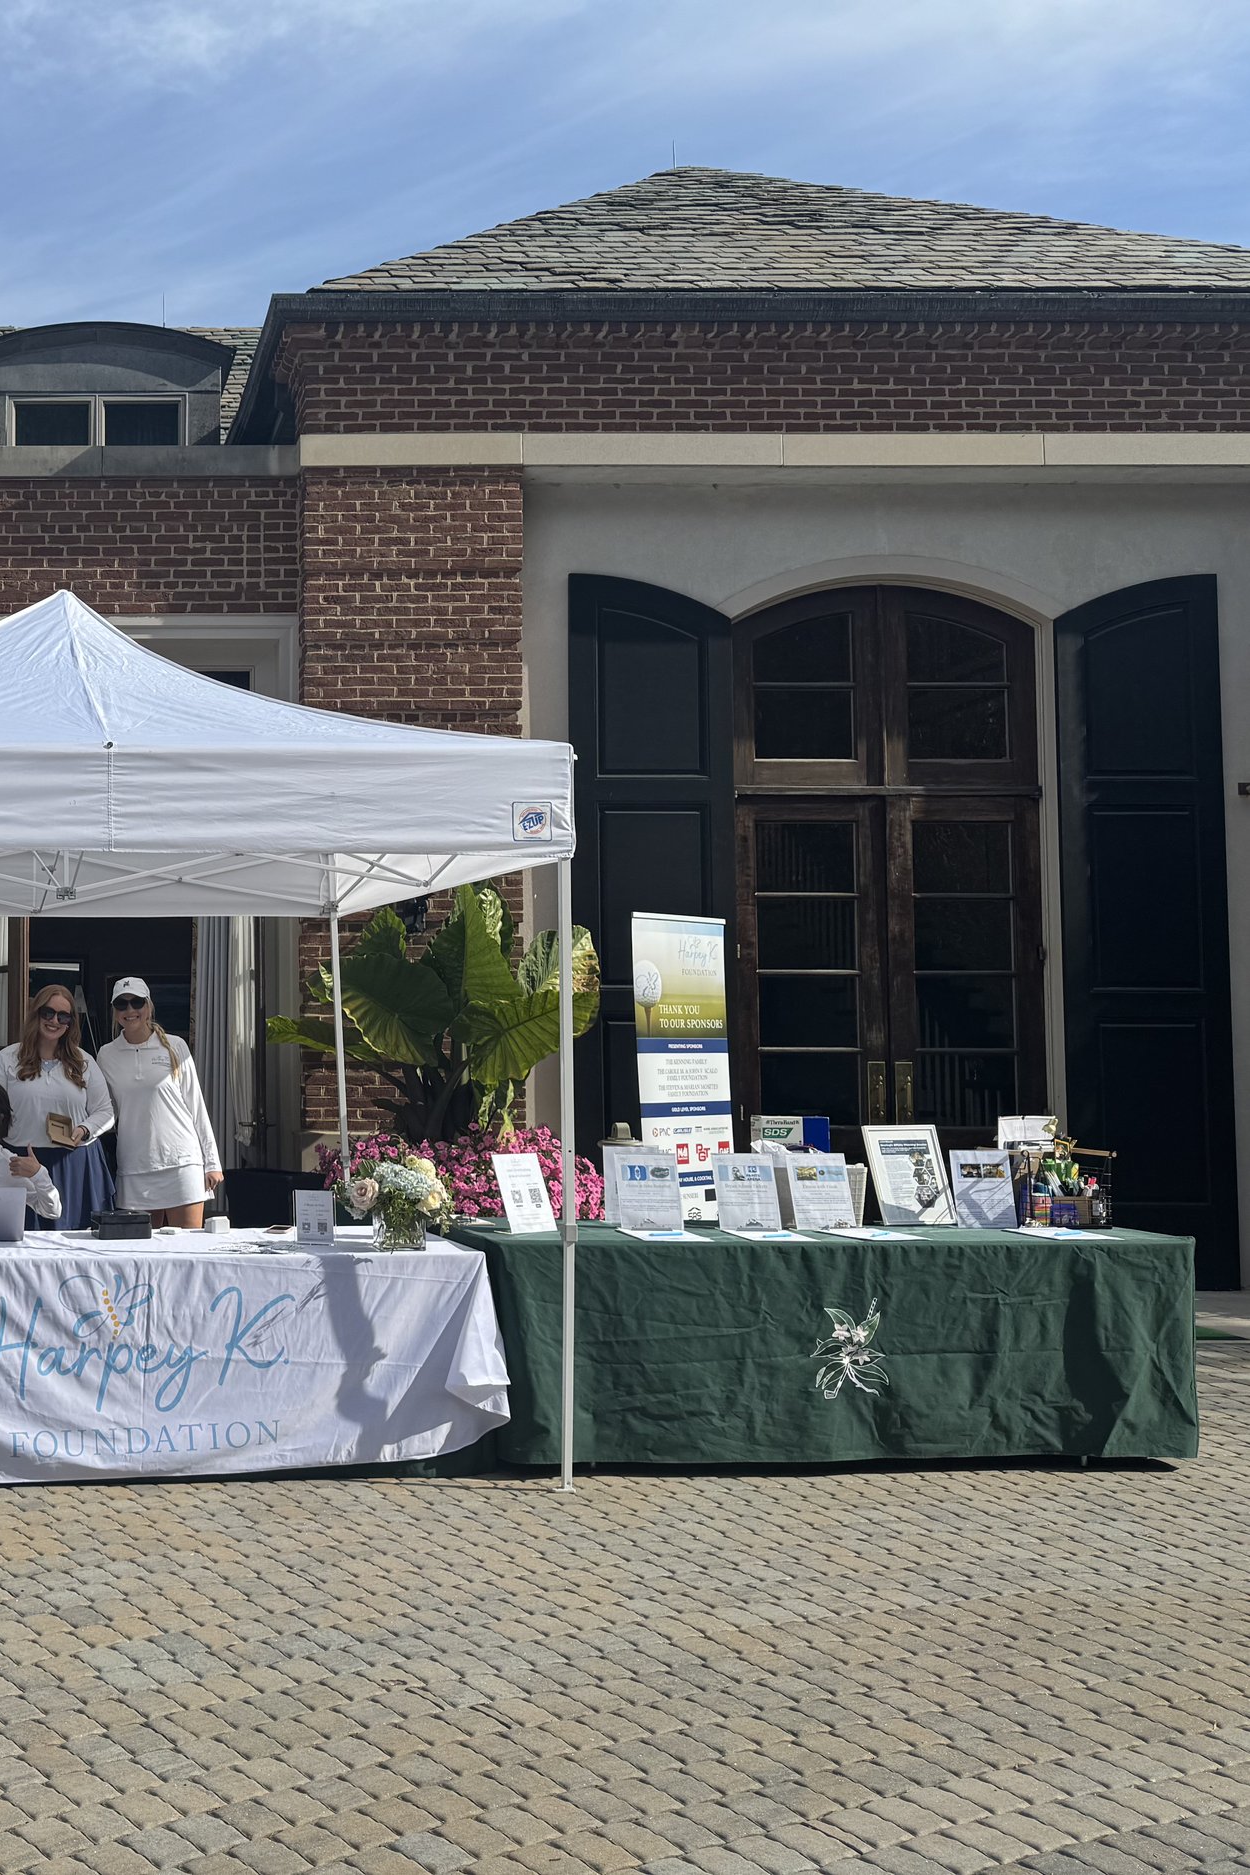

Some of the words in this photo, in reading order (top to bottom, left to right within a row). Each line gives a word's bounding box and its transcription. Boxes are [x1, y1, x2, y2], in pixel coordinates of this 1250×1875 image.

[658, 1004, 683, 1014] THANK
[684, 1005, 700, 1014] YOU
[659, 1018, 669, 1028] TO
[670, 1018, 686, 1028] OUR
[686, 1019, 723, 1029] SPONSORS
[764, 1128, 788, 1136] SDS
[9, 1419, 280, 1458] FOUNDATION
